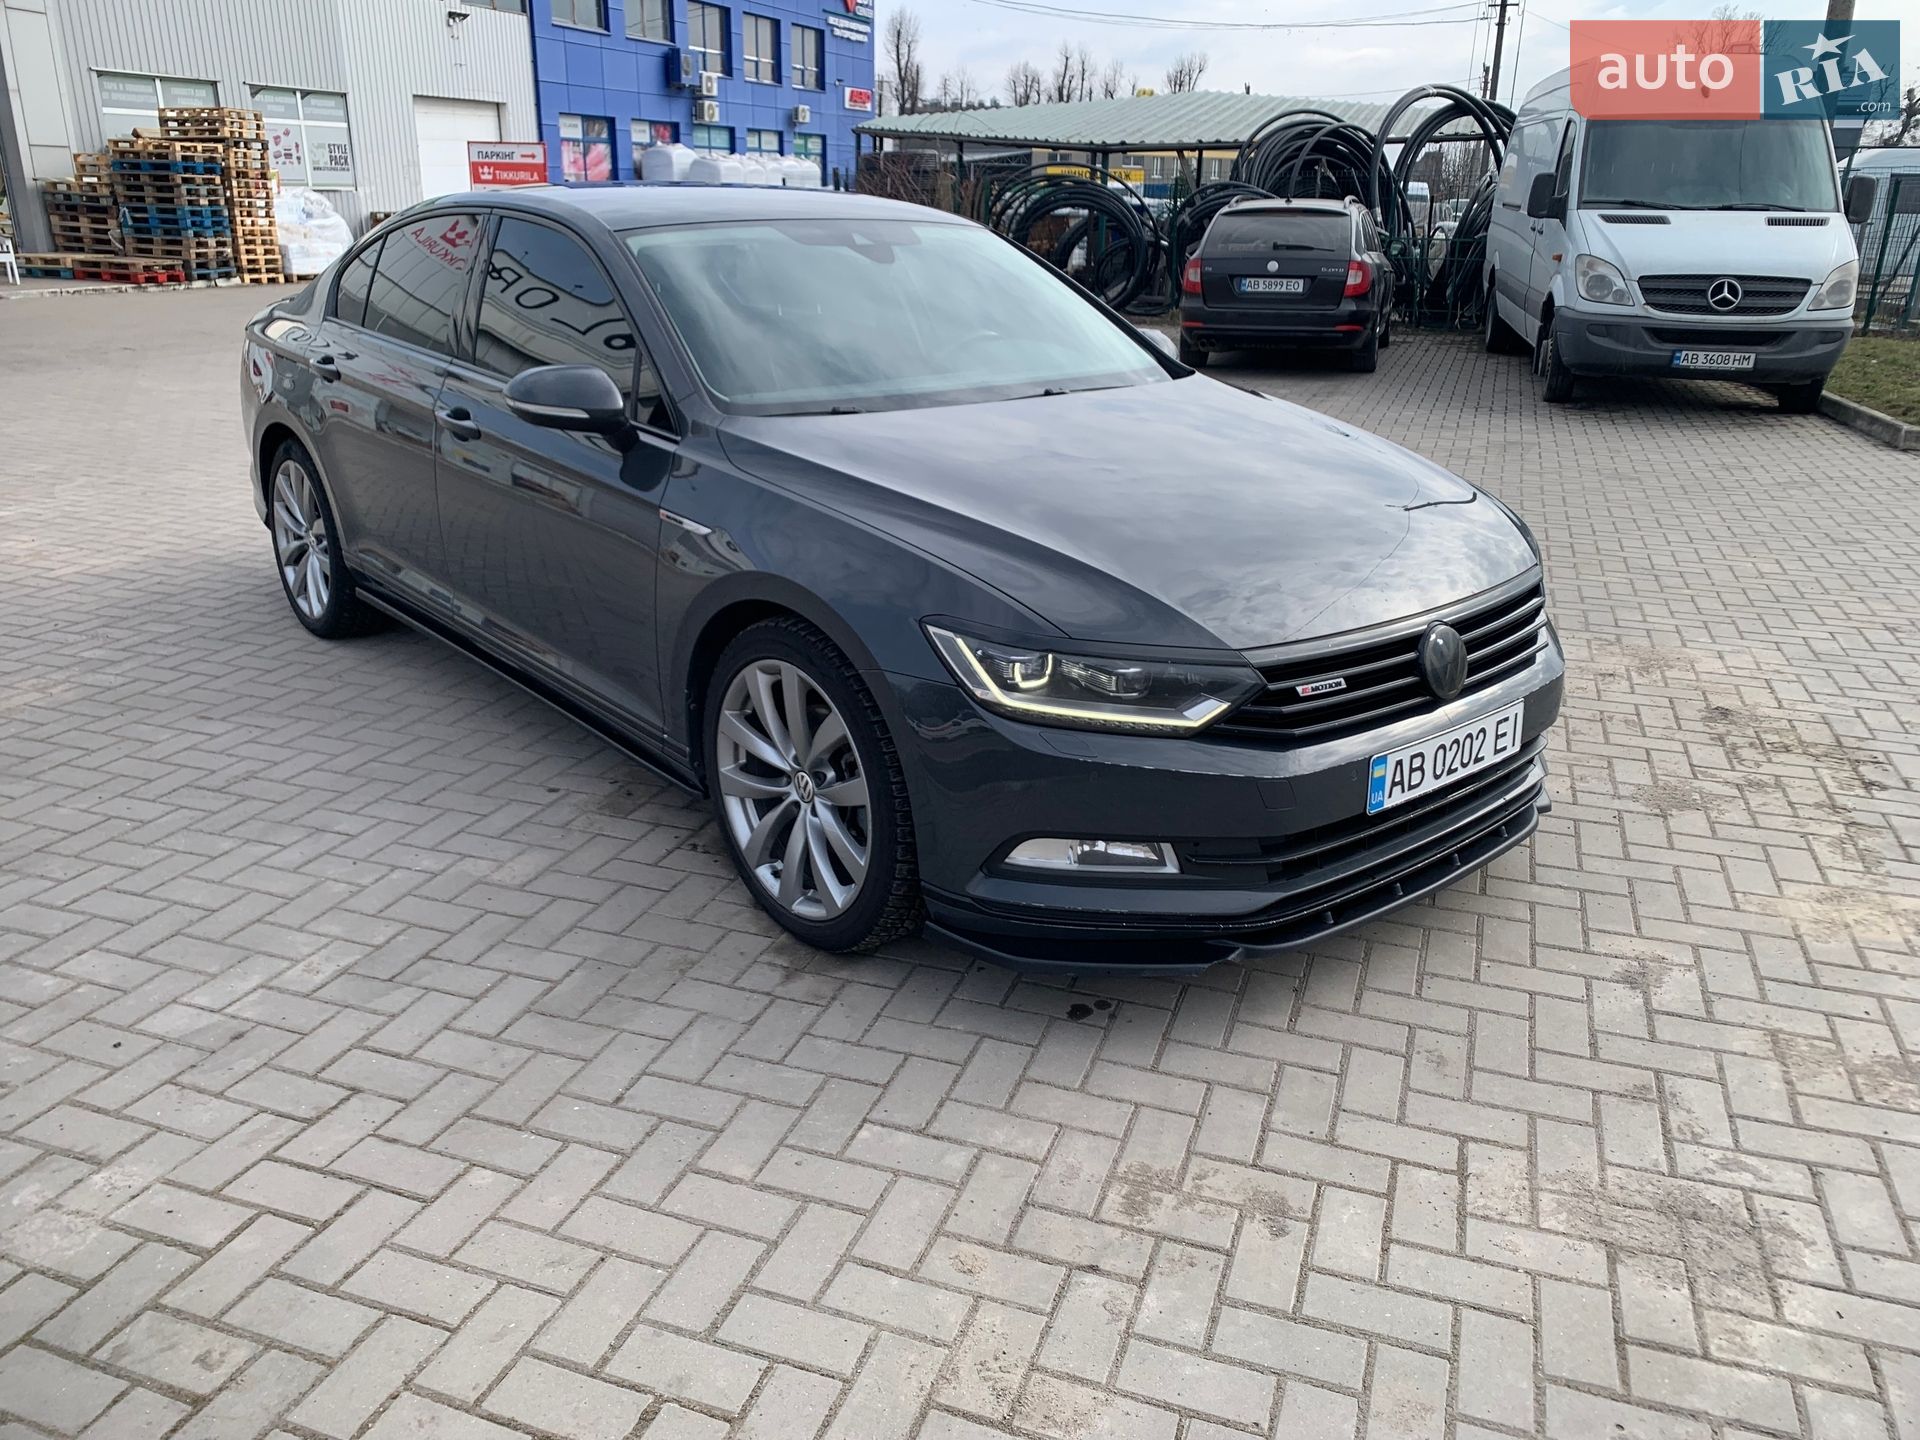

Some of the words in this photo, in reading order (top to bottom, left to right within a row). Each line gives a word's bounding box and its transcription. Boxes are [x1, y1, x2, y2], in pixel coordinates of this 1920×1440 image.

[327, 143, 348, 154] STYLE
[329, 154, 349, 166] PACK
[477, 150, 516, 161] ПАРКІНГ
[495, 170, 540, 181] TIKKURILA
[1246, 280, 1260, 290] AB
[1263, 280, 1284, 291] 5899
[1286, 281, 1300, 291] EO
[1681, 353, 1699, 365] AB
[1701, 353, 1731, 366] 3608
[1732, 354, 1752, 366] HM
[1387, 751, 1426, 799] AB
[1432, 726, 1487, 781] 0202
[1493, 712, 1518, 756] EI
[1371, 790, 1384, 805] UA
